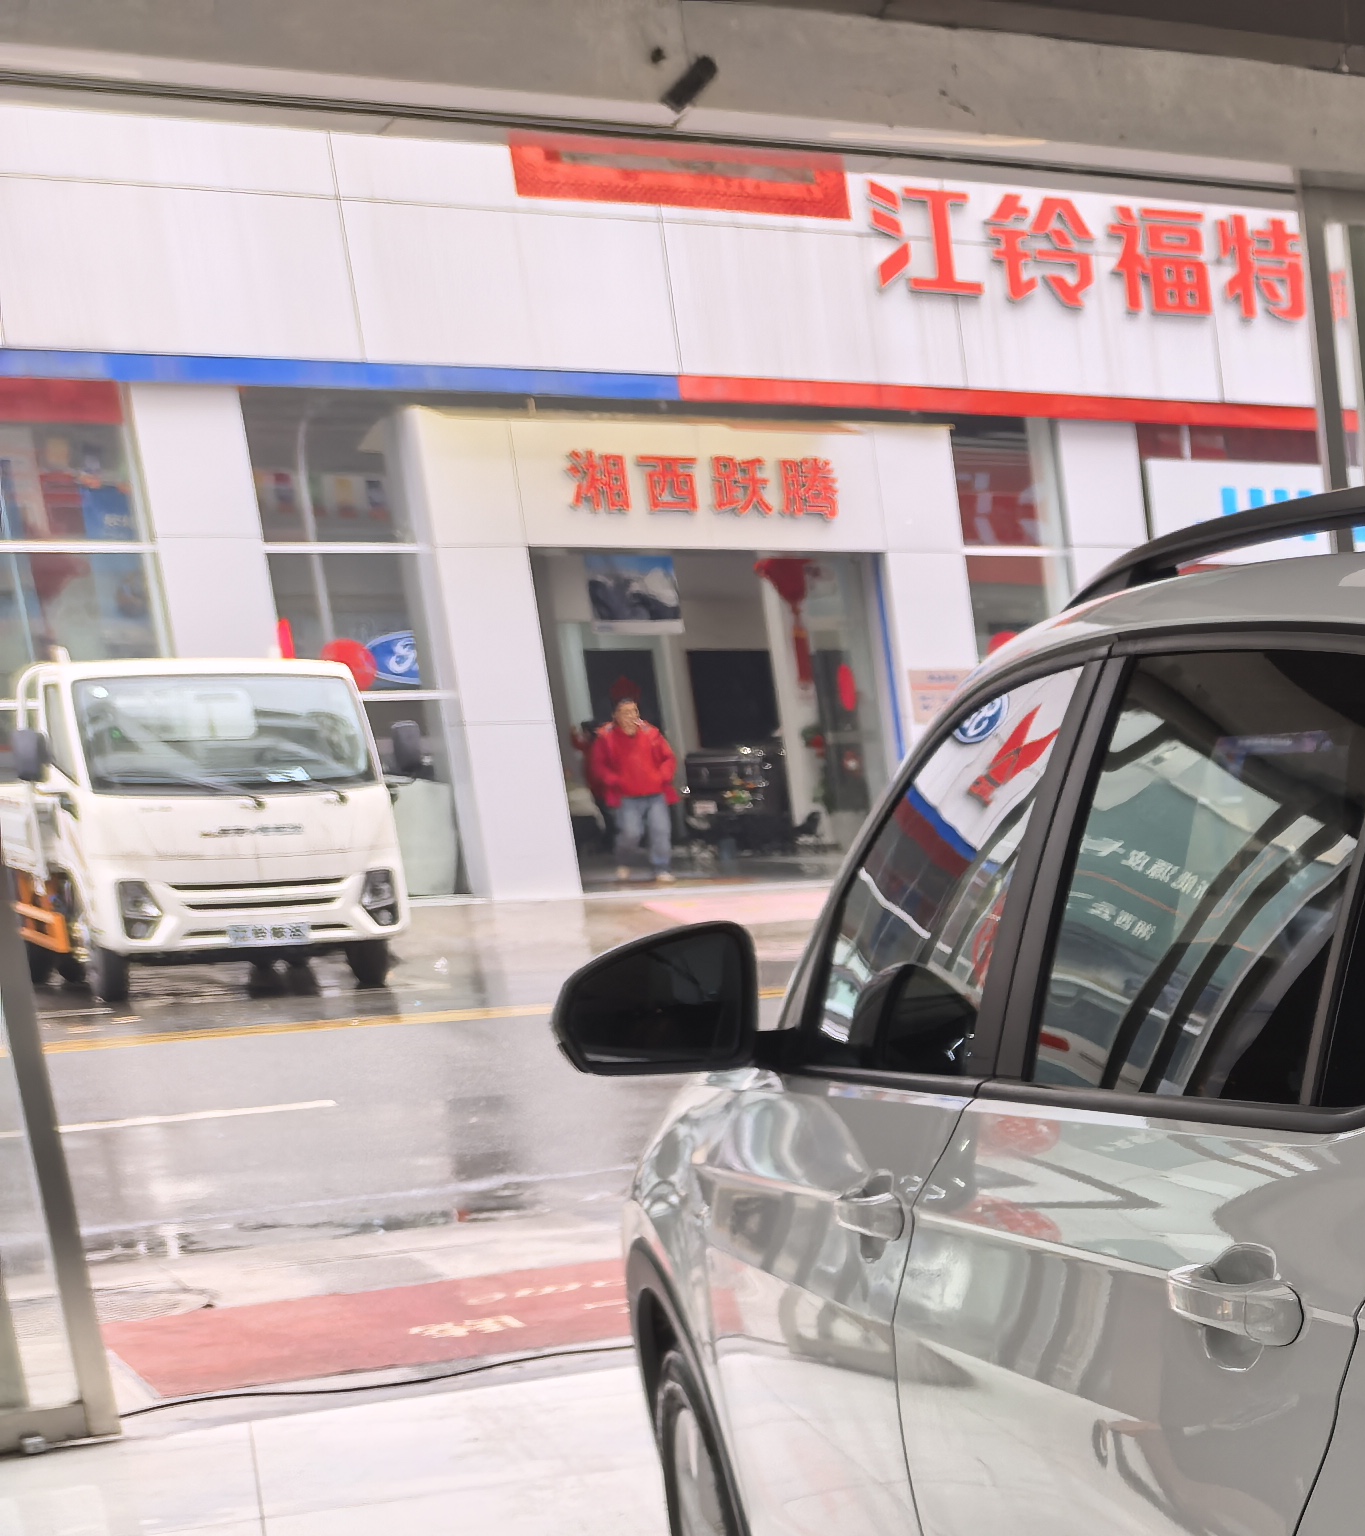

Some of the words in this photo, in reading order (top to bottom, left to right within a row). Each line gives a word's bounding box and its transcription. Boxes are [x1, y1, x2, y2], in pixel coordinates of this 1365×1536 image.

[867, 178, 1309, 322] 江铃福特
[567, 448, 840, 520] 湘西跃腾
